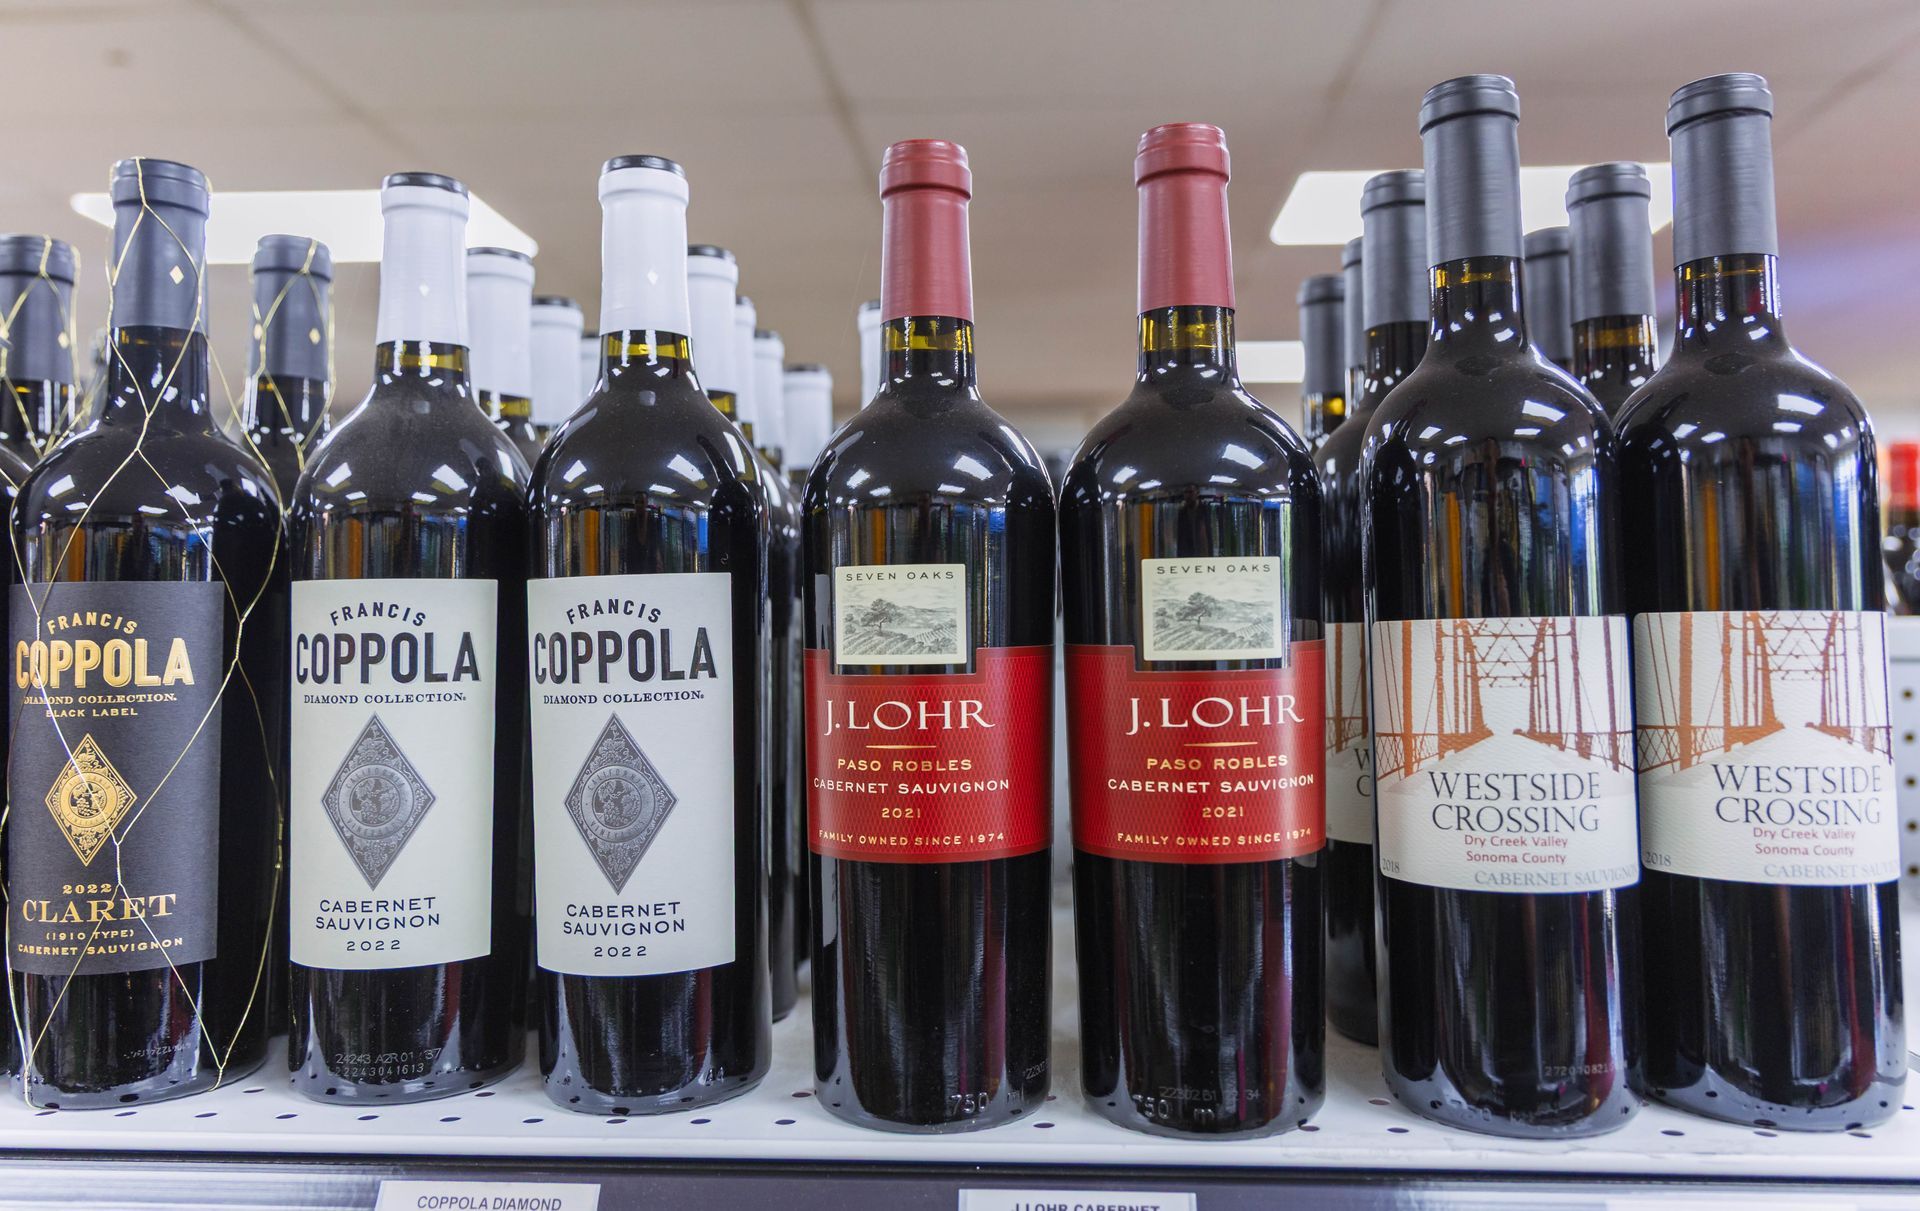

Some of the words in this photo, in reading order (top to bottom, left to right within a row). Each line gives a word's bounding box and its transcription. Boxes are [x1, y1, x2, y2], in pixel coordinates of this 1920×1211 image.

[846, 572, 896, 581] SEVEN
[906, 571, 954, 580] OAKS
[1156, 565, 1216, 575] SEVEN
[1226, 564, 1271, 573] OAKS
[330, 602, 426, 626] FRANCIS
[566, 599, 661, 625] FRANCIS
[47, 611, 138, 634] FRANCIS
[15, 637, 195, 690] COPPOLA
[296, 631, 481, 685] COPPOLA
[534, 627, 718, 685] COPPOLA
[24, 696, 73, 705] DIAMOND
[304, 694, 358, 704] DIAMOND
[543, 694, 597, 704] DIAMOND
[46, 709, 85, 718] BLACK
[92, 708, 138, 717] LABEL
[838, 758, 881, 771] PASO
[892, 759, 972, 772] ROBLES
[1147, 758, 1201, 770] PASO
[1214, 754, 1288, 770] ROBLES
[813, 777, 888, 794] CABERNET
[898, 778, 1009, 794] SAUVIGNON
[1108, 779, 1210, 793] CABERNET
[1220, 774, 1314, 793] SAUVIGNON
[1427, 771, 1600, 801] WESTSIDE
[1711, 764, 1881, 794] WESTSIDE
[881, 807, 921, 819] 2021
[1202, 806, 1244, 818] 2021
[1432, 803, 1599, 833] CROSSING
[1715, 796, 1880, 825] CROSSING
[819, 829, 853, 843] FAMILY
[859, 835, 908, 845] OWNED
[914, 836, 962, 846] SINCE
[970, 832, 1004, 844] 1974
[1117, 832, 1168, 845] FAMILY
[1176, 836, 1231, 846] OWNED
[1238, 832, 1280, 845] SINCE
[1286, 827, 1312, 840] 1974
[1464, 835, 1486, 848] Dry
[1490, 835, 1527, 847] Creek
[1532, 836, 1568, 848] Valley
[1753, 827, 1776, 840] Dry
[1781, 828, 1818, 839] Creek
[1823, 829, 1857, 840] Valley
[1466, 851, 1517, 863] Sonoma
[1522, 852, 1567, 864] County
[1755, 843, 1809, 855] Sonoma
[1813, 845, 1855, 856] County
[1382, 858, 1399, 873] 2018
[1645, 852, 1671, 867] 2018
[1474, 870, 1569, 886] CABERNET
[1764, 863, 1857, 878] CABERNET
[62, 883, 112, 894] 2022
[22, 893, 176, 923] CLARET
[319, 897, 436, 913] CABERNET
[566, 901, 681, 918] CABERNET
[315, 913, 440, 930] SAUVIGNON
[563, 919, 685, 936] SAUVIGNON
[46, 932, 86, 940] (1910
[92, 929, 135, 939] TYPE)
[18, 943, 78, 956] CABERNET
[87, 937, 183, 955] SAUVIGNON
[346, 940, 400, 951] 2022
[594, 946, 647, 957] 2022
[417, 1196, 488, 1209] COPPOLA
[492, 1198, 562, 1211] DIAMOND
